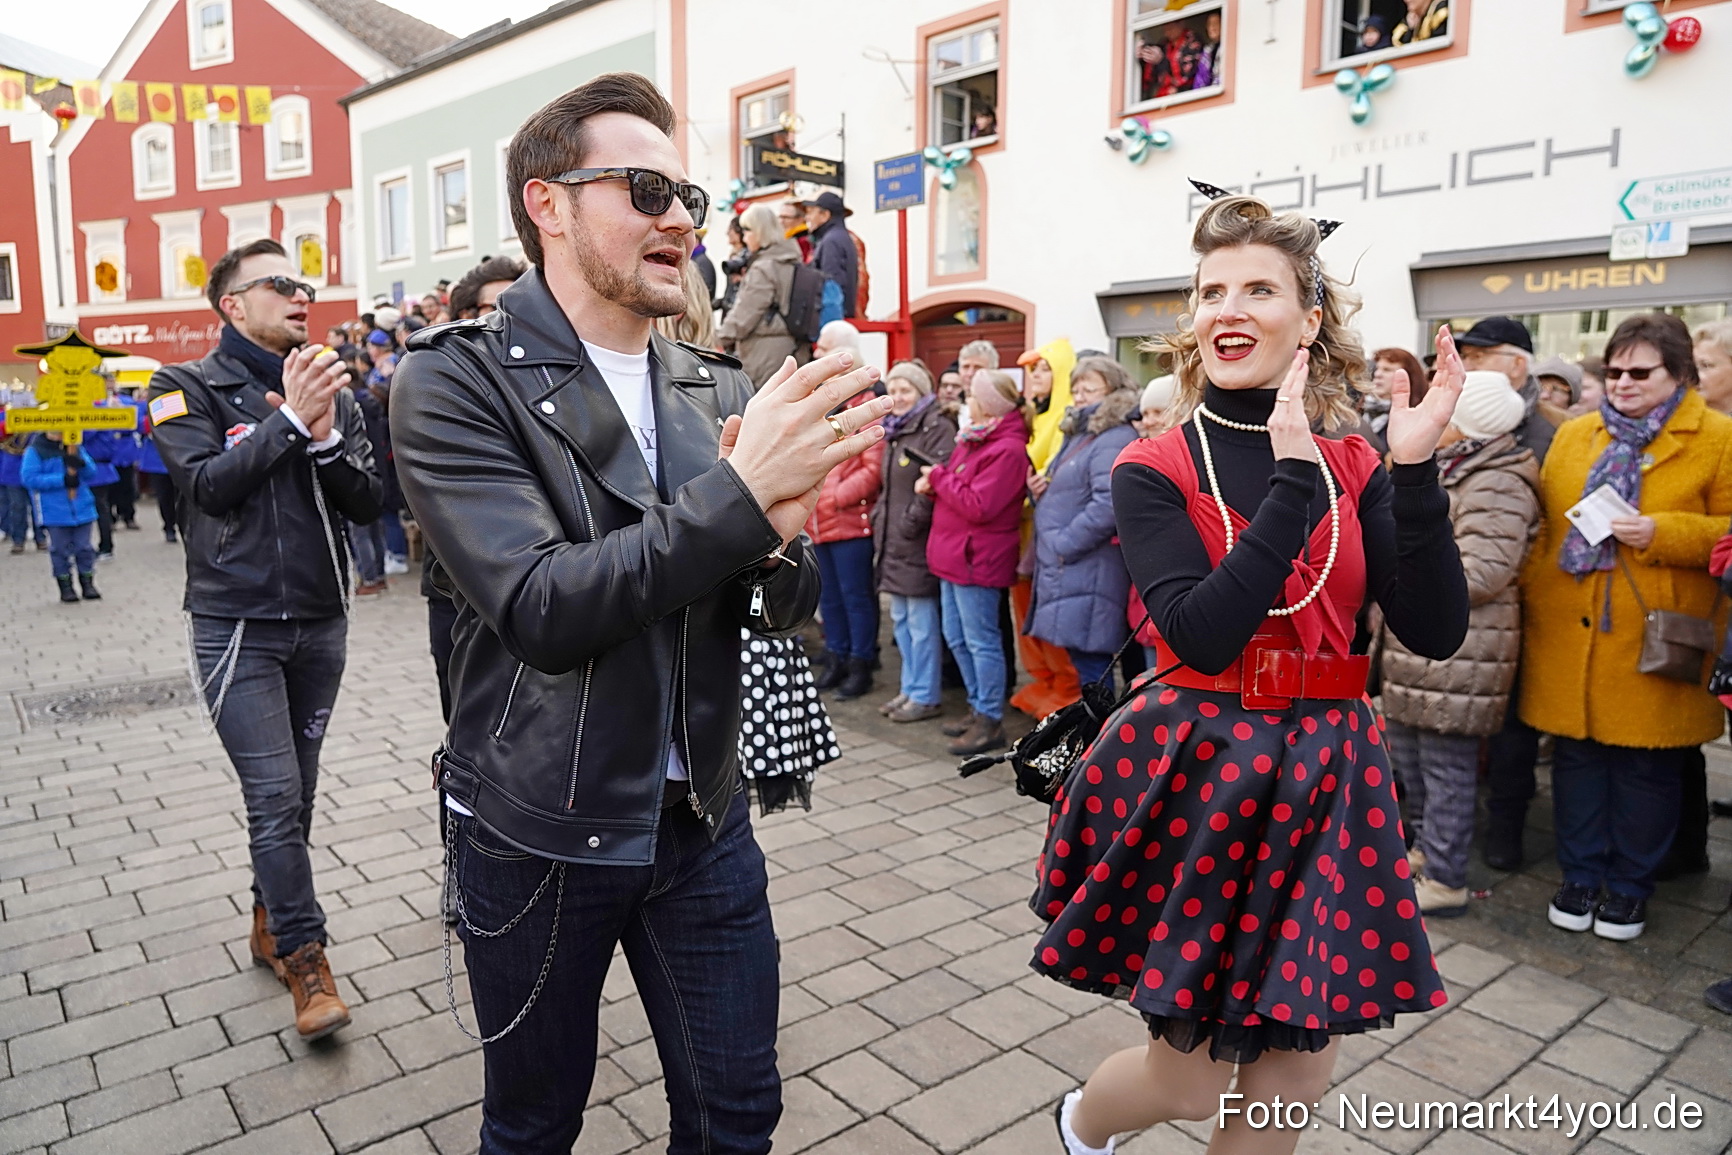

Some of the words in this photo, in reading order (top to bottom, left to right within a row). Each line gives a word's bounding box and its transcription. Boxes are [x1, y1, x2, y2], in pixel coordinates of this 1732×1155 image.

[1329, 130, 1429, 163] JUWELIER
[1653, 176, 1732, 195] Kallmünz
[1524, 262, 1667, 293] UHREN
